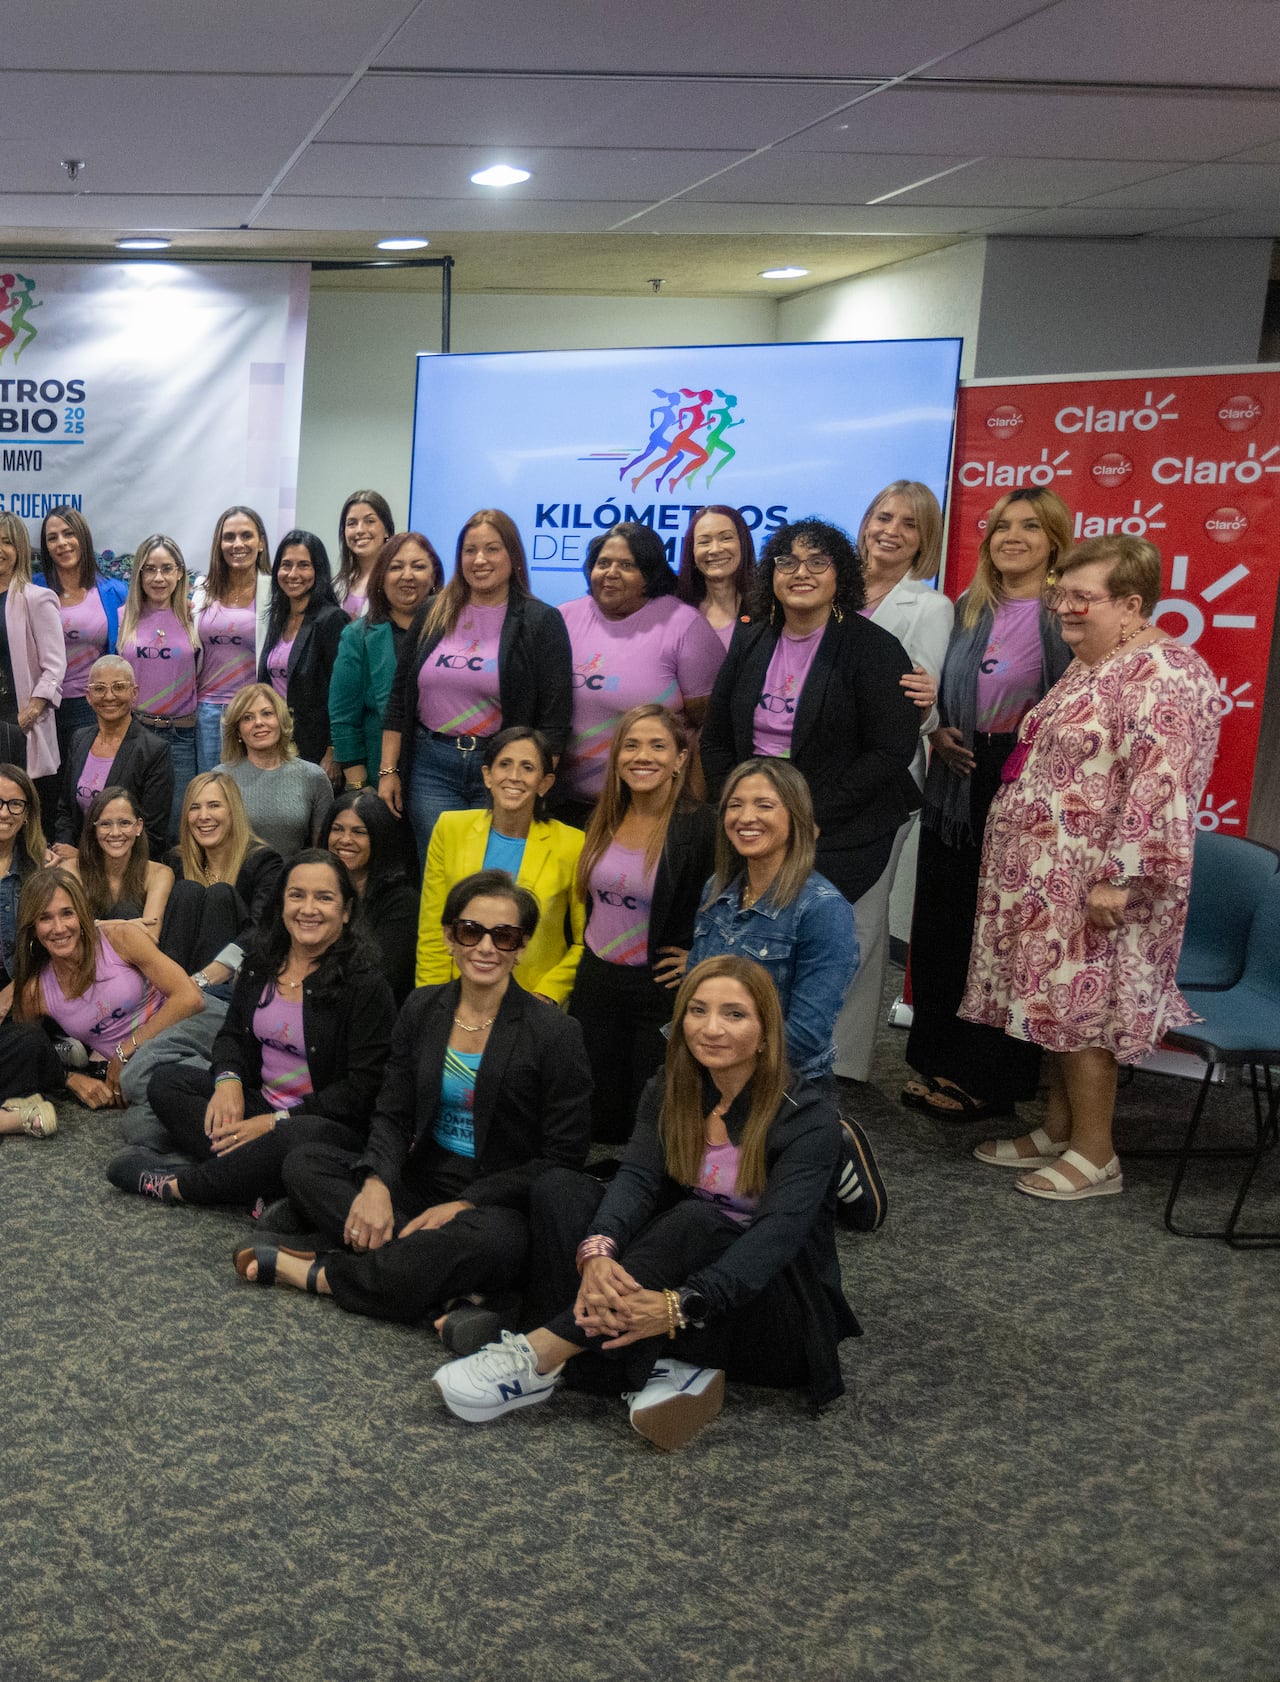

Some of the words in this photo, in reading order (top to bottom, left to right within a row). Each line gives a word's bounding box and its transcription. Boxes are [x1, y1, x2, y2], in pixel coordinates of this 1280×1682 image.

[64, 407, 85, 420] 20
[987, 416, 1018, 427] Claro
[1055, 405, 1159, 434] Claro
[1218, 407, 1254, 420] Claro
[64, 421, 85, 434] 25
[3, 449, 43, 472] MAYO
[1092, 464, 1125, 476] Claro
[959, 460, 1055, 487] Claro
[1151, 456, 1263, 485] Claro
[535, 497, 789, 532] KILÓMETOS
[1074, 511, 1147, 538] laro
[1205, 519, 1241, 531] Claro
[533, 534, 580, 561] DE
[209, 636, 243, 646] KDC
[137, 647, 171, 660] KDC
[435, 654, 484, 671] KDC
[572, 672, 606, 691] DC
[597, 889, 638, 911] KDC
[497, 1379, 523, 1403] N
